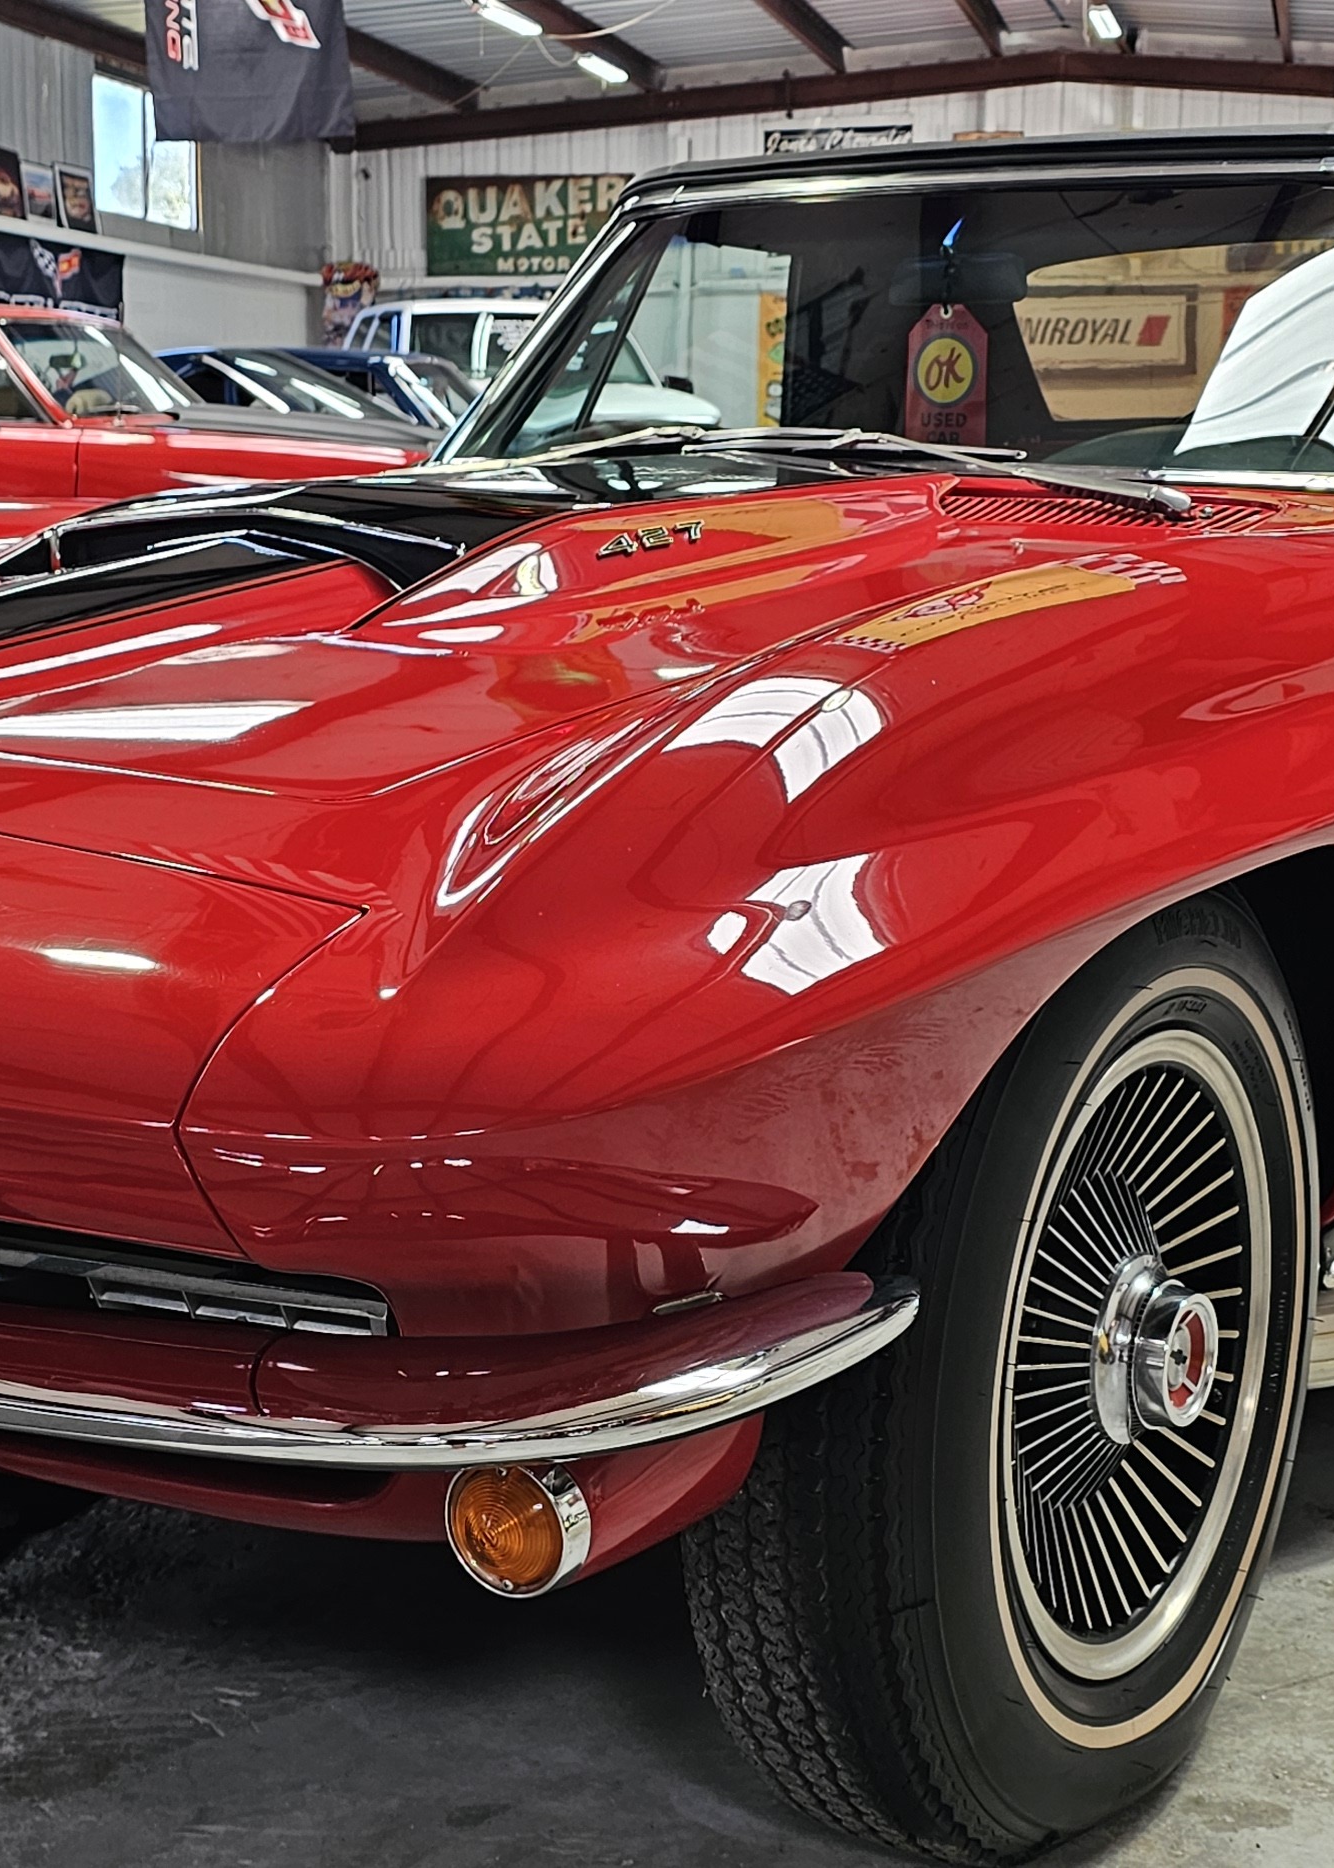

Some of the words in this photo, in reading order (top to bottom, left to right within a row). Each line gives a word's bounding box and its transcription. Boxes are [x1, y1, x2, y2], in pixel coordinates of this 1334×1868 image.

[433, 178, 626, 230] QUAKER
[471, 220, 588, 254] STATE
[497, 255, 571, 273] MOTOR
[1018, 316, 1133, 346] NIROYAL
[924, 347, 966, 391] OK
[920, 412, 967, 428] USED
[597, 518, 704, 556] 427
